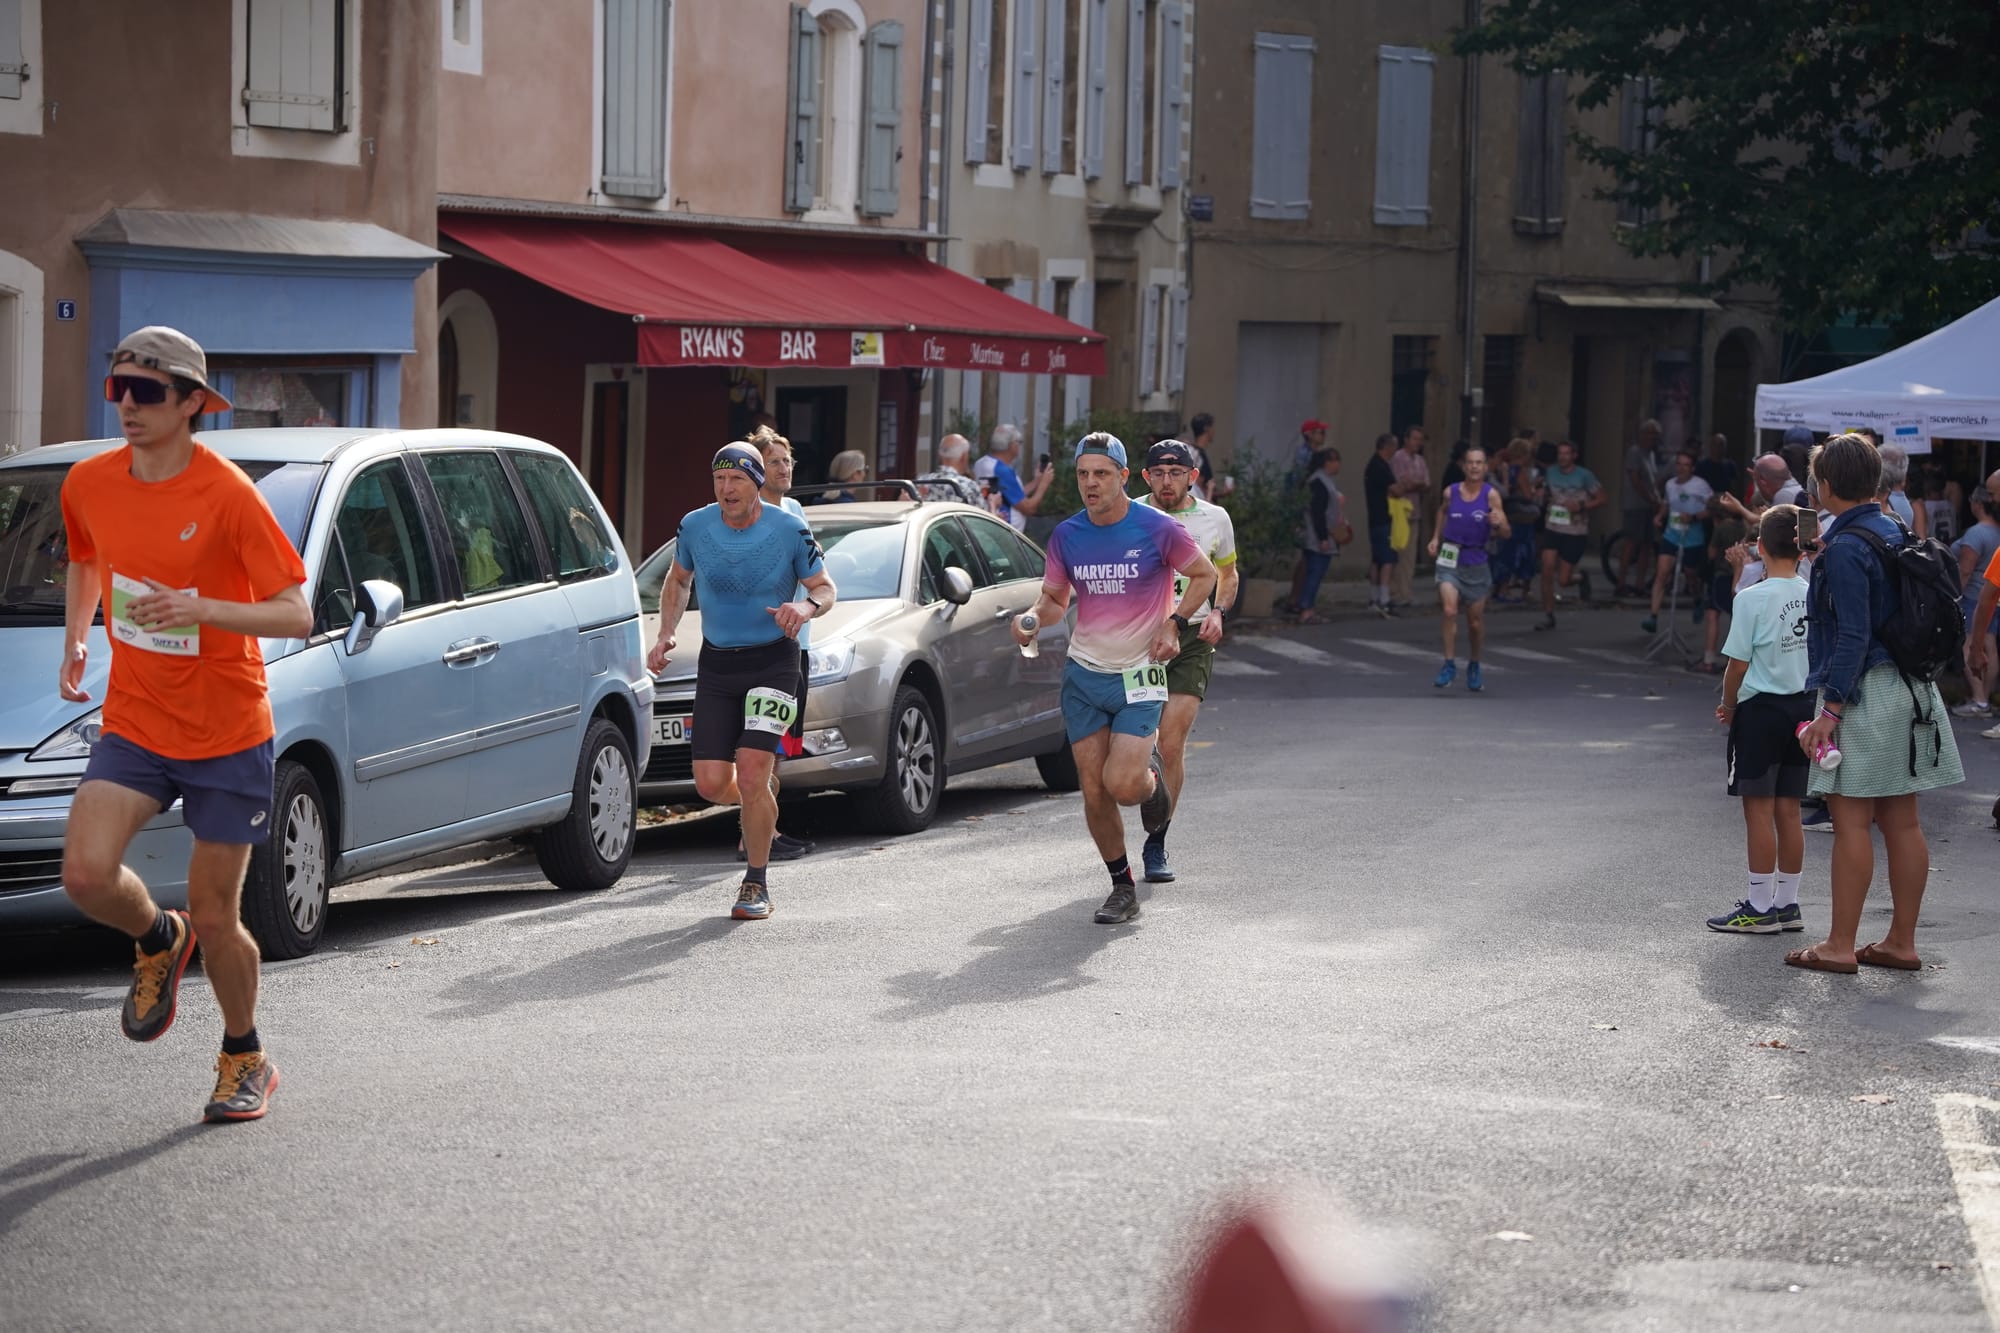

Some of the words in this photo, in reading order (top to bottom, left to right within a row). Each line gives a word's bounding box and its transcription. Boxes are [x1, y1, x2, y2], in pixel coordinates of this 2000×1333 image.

[63, 303, 70, 318] 6
[680, 327, 744, 358] RYAN'S
[780, 330, 816, 360] BAR
[923, 336, 945, 362] Chez
[969, 342, 1005, 367] Martine
[1020, 350, 1030, 367] et
[1048, 345, 1067, 372] John
[1073, 563, 1139, 581] MARVEJOLS
[1086, 580, 1126, 595] MENDE
[1133, 668, 1165, 687] 108
[752, 698, 790, 722] 120
